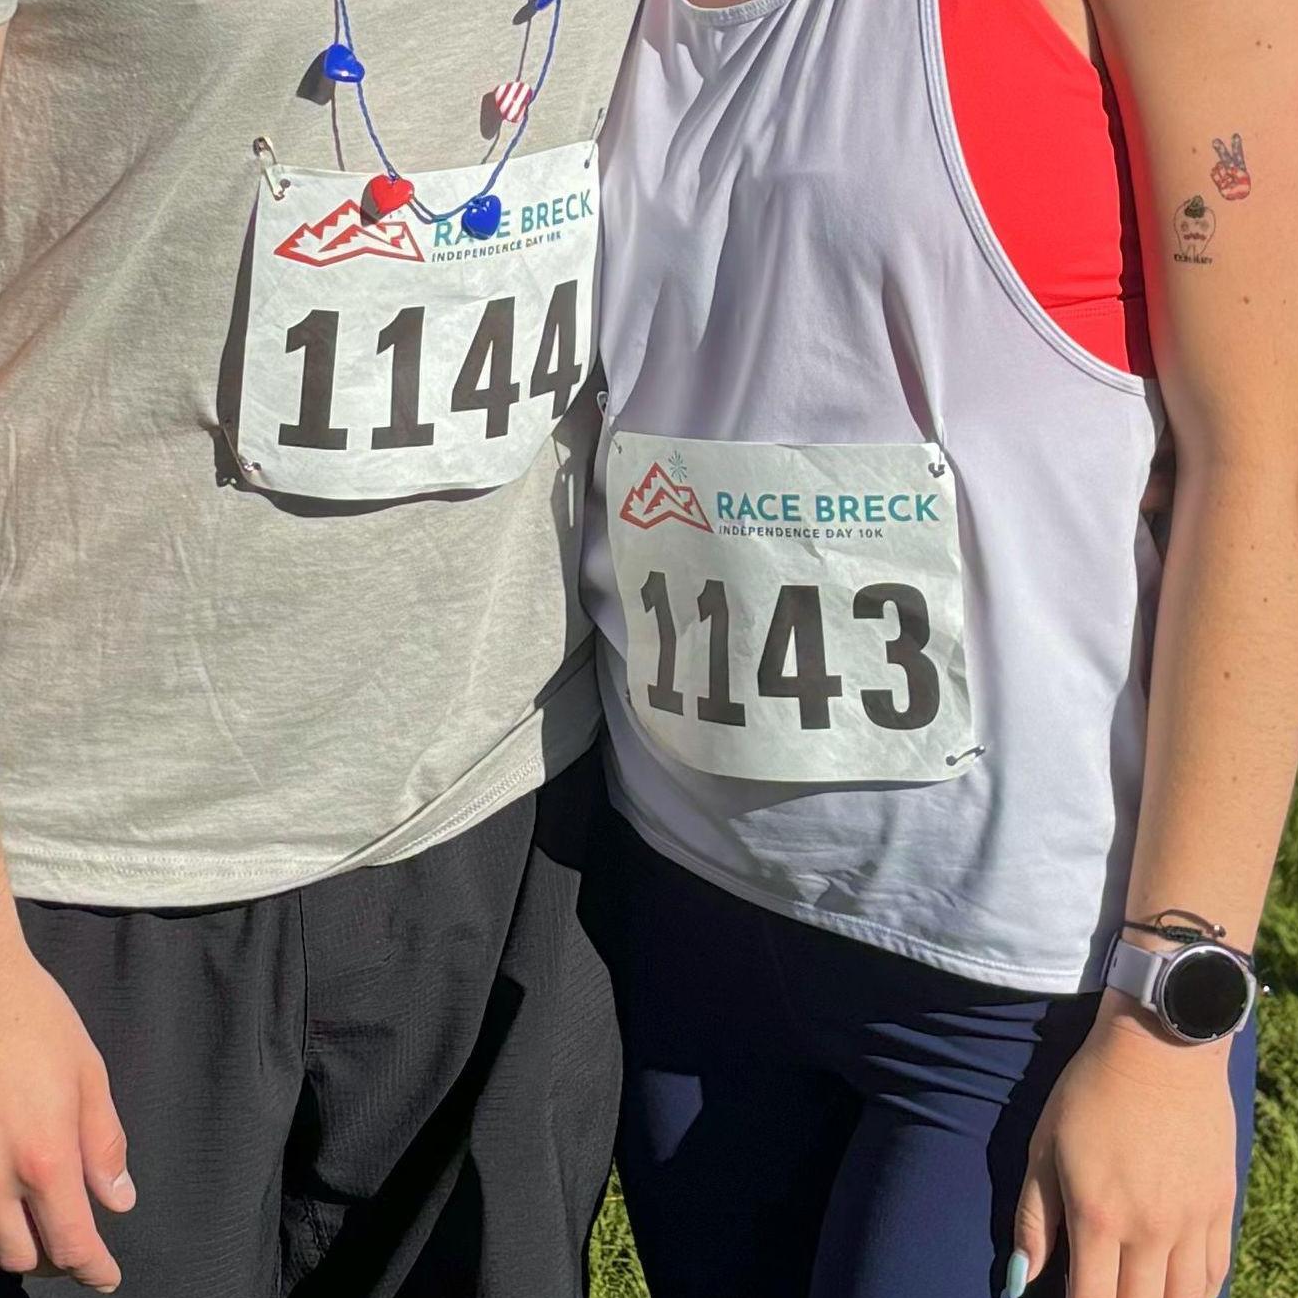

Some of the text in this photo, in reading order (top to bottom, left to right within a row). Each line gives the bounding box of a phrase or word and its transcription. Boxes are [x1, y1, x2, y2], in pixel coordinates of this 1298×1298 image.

[521, 189, 594, 233] BRECK
[431, 240, 522, 262] INDEPENDENCE
[525, 235, 544, 248] DAY
[277, 280, 582, 451] 1144
[717, 492, 941, 522] RACE BRECK
[719, 526, 884, 539] INDEPENDENCE DAY 10K
[640, 571, 941, 731] 1143
